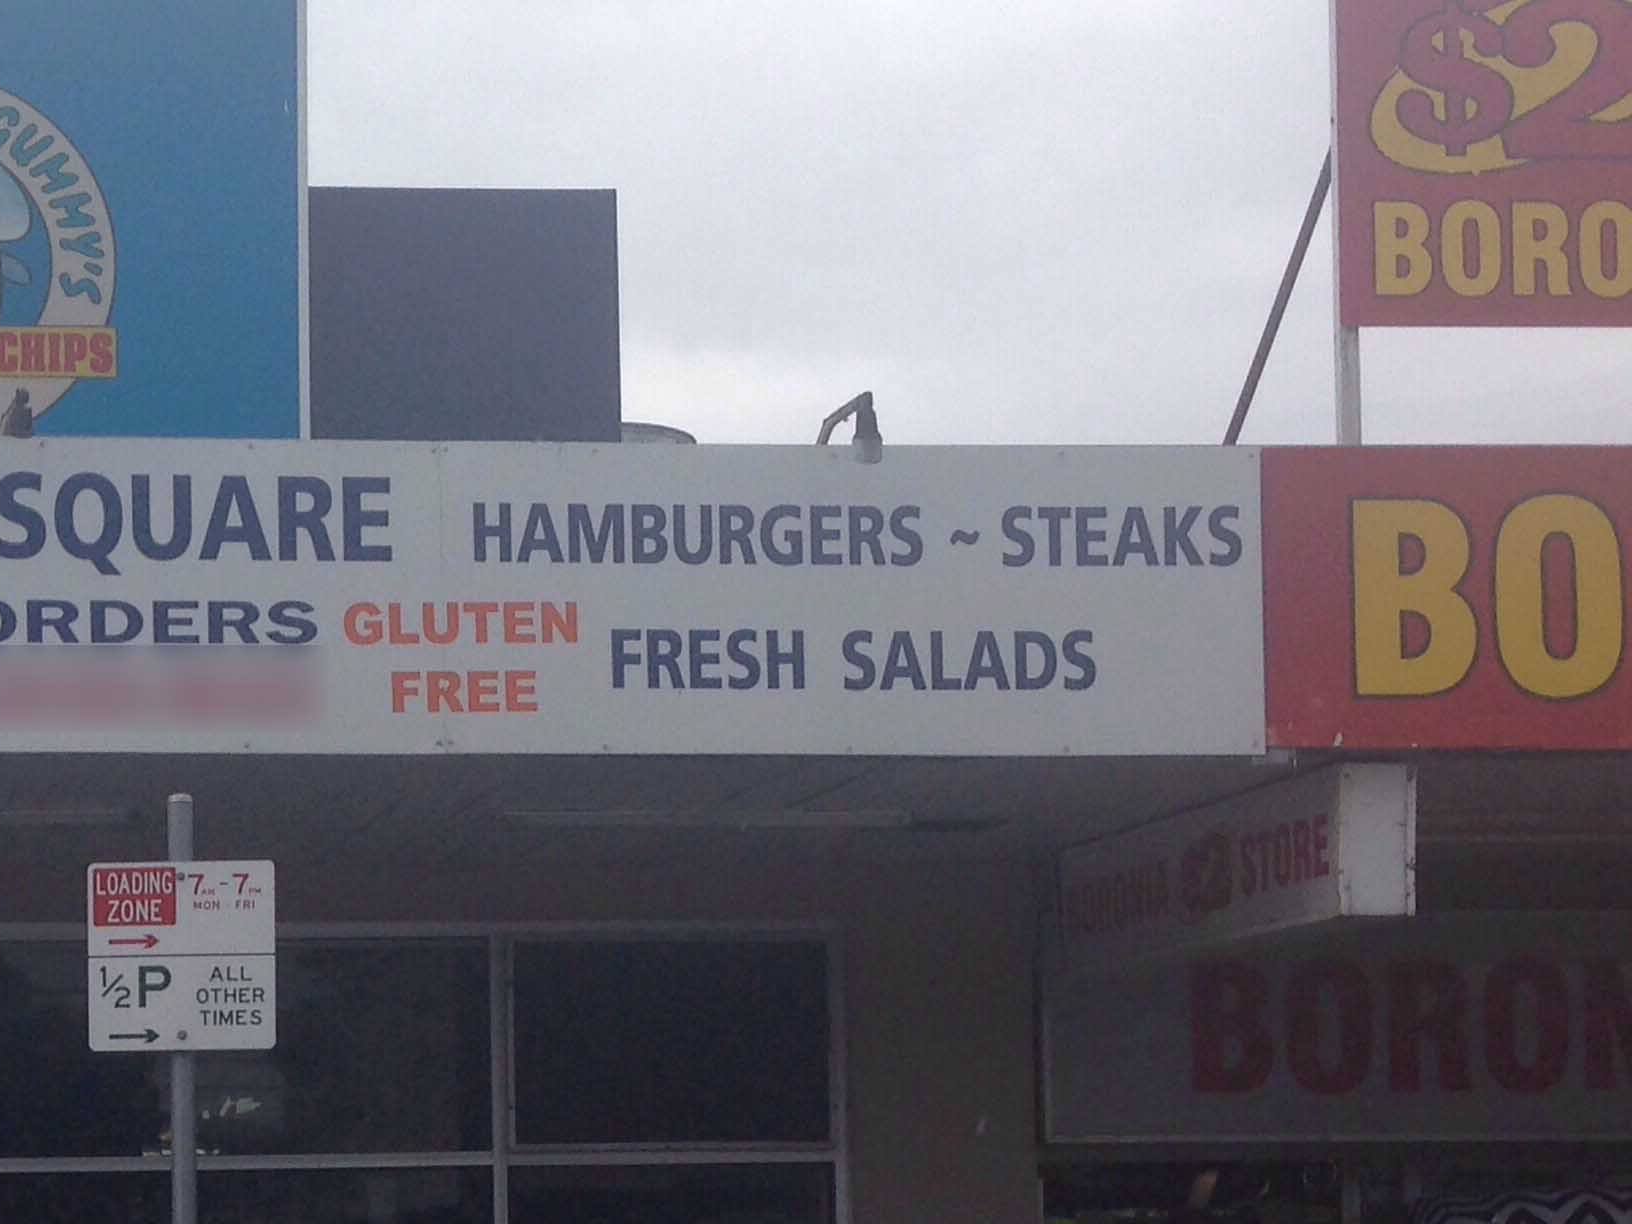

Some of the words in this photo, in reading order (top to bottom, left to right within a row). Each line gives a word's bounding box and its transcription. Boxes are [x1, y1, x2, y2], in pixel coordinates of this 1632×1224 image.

[1373, 199, 1632, 298] BORO
[471, 501, 924, 567] HAMBURGERS
[1001, 505, 1244, 568] STEAKS
[1351, 492, 1624, 701] BO
[343, 601, 580, 646] GLUTEN
[610, 628, 807, 691] FRESH
[841, 628, 1098, 692] SALADS
[390, 670, 540, 714] FREE
[1240, 814, 1331, 896] STORE
[96, 871, 173, 895] LOADING
[107, 899, 162, 923] ZONE
[193, 901, 221, 911] MON
[235, 900, 256, 910] FRI
[196, 988, 265, 1004] OTHER
[209, 966, 253, 982] ALL
[200, 1010, 263, 1026] TIMES
